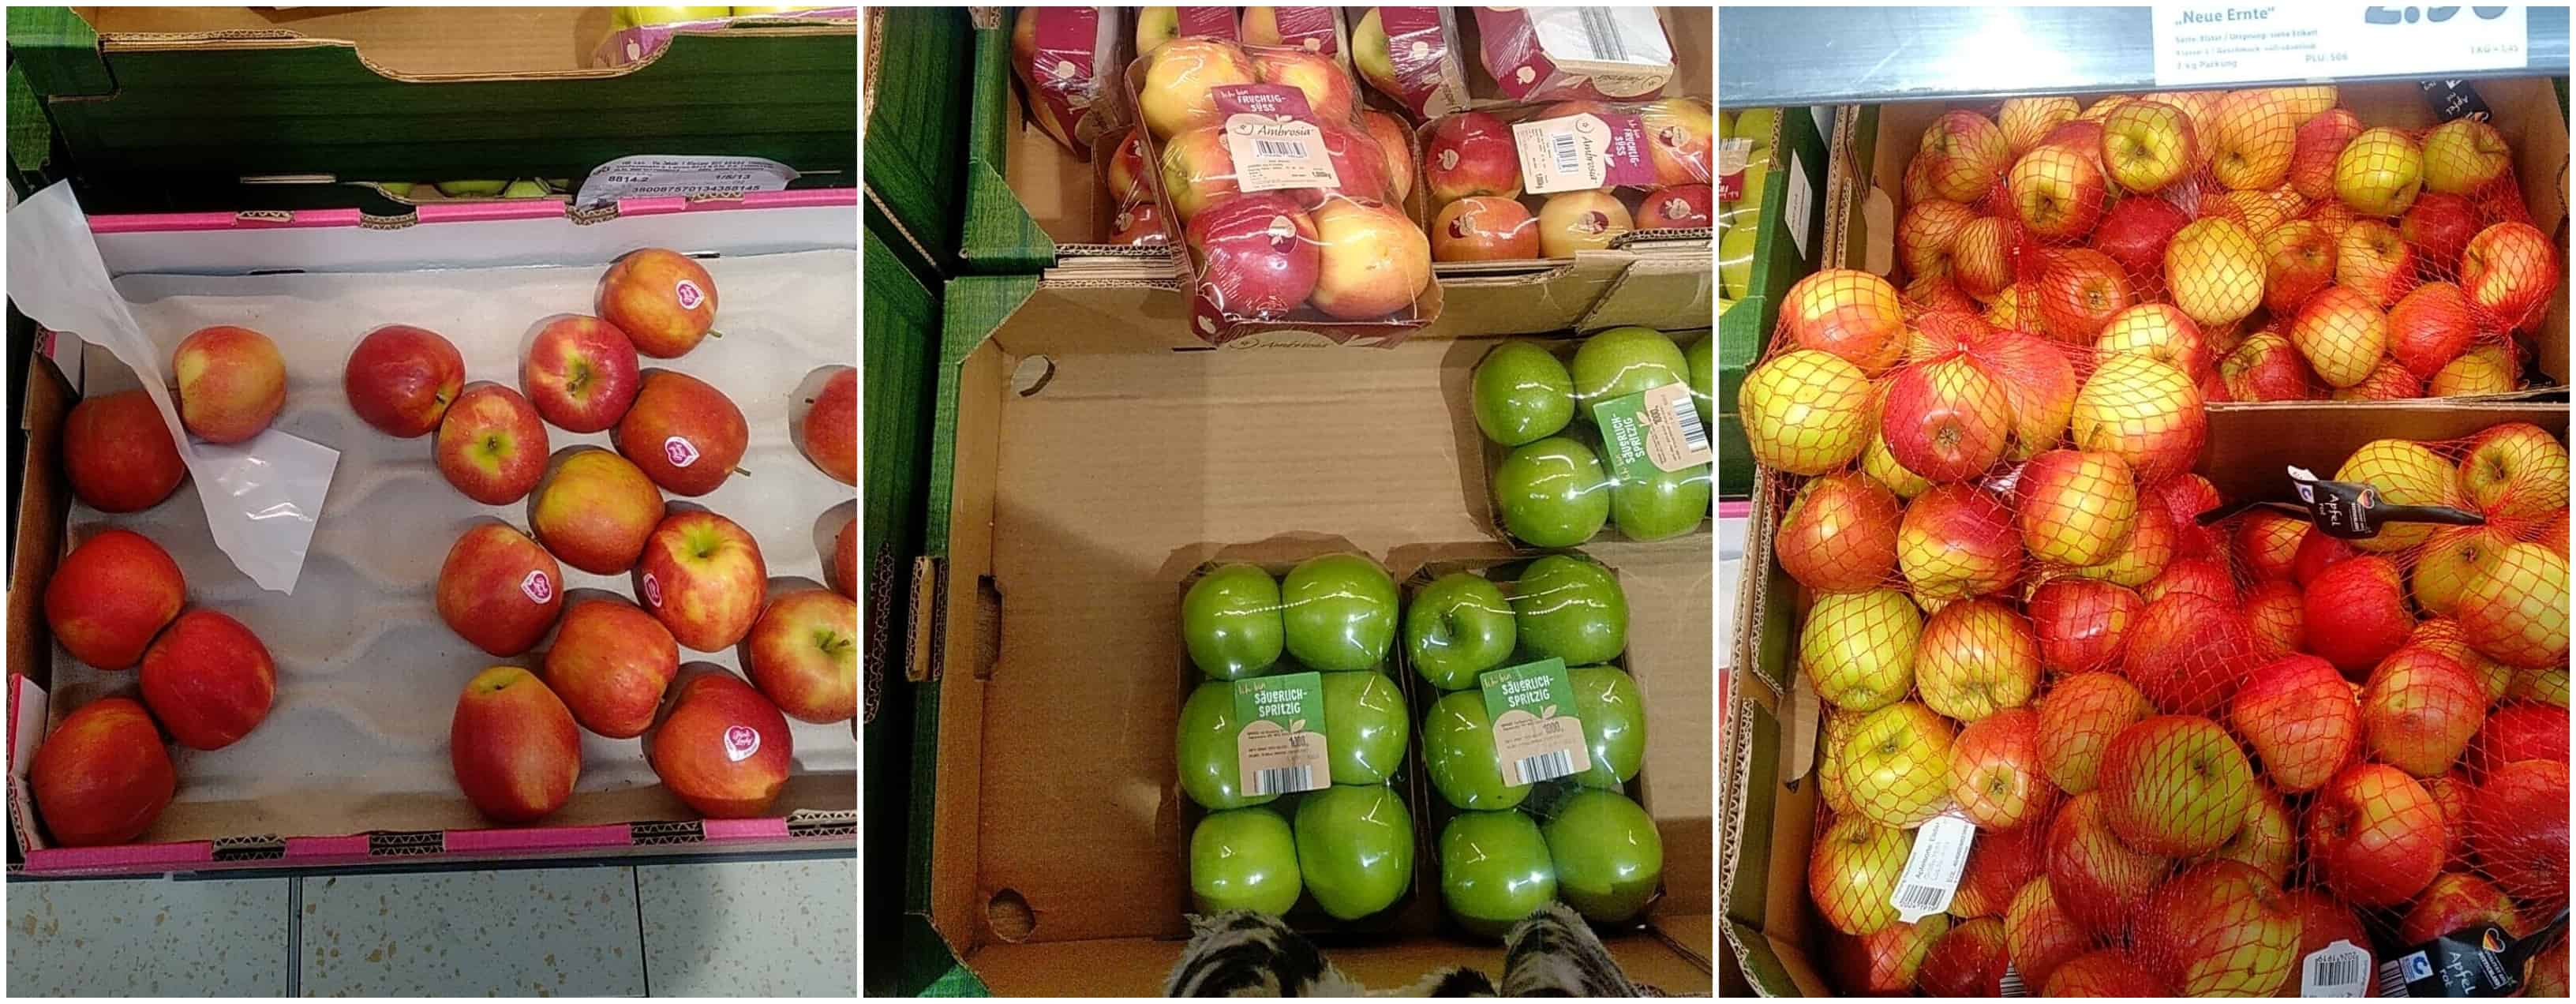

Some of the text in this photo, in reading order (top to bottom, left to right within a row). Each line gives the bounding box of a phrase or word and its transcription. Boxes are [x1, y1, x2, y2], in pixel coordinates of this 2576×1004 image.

[1257, 126, 1312, 137] Ambrosia
[2324, 493, 2343, 527] Apfel
[2439, 960, 2454, 987] rot
[2447, 951, 2476, 995] Apfel
